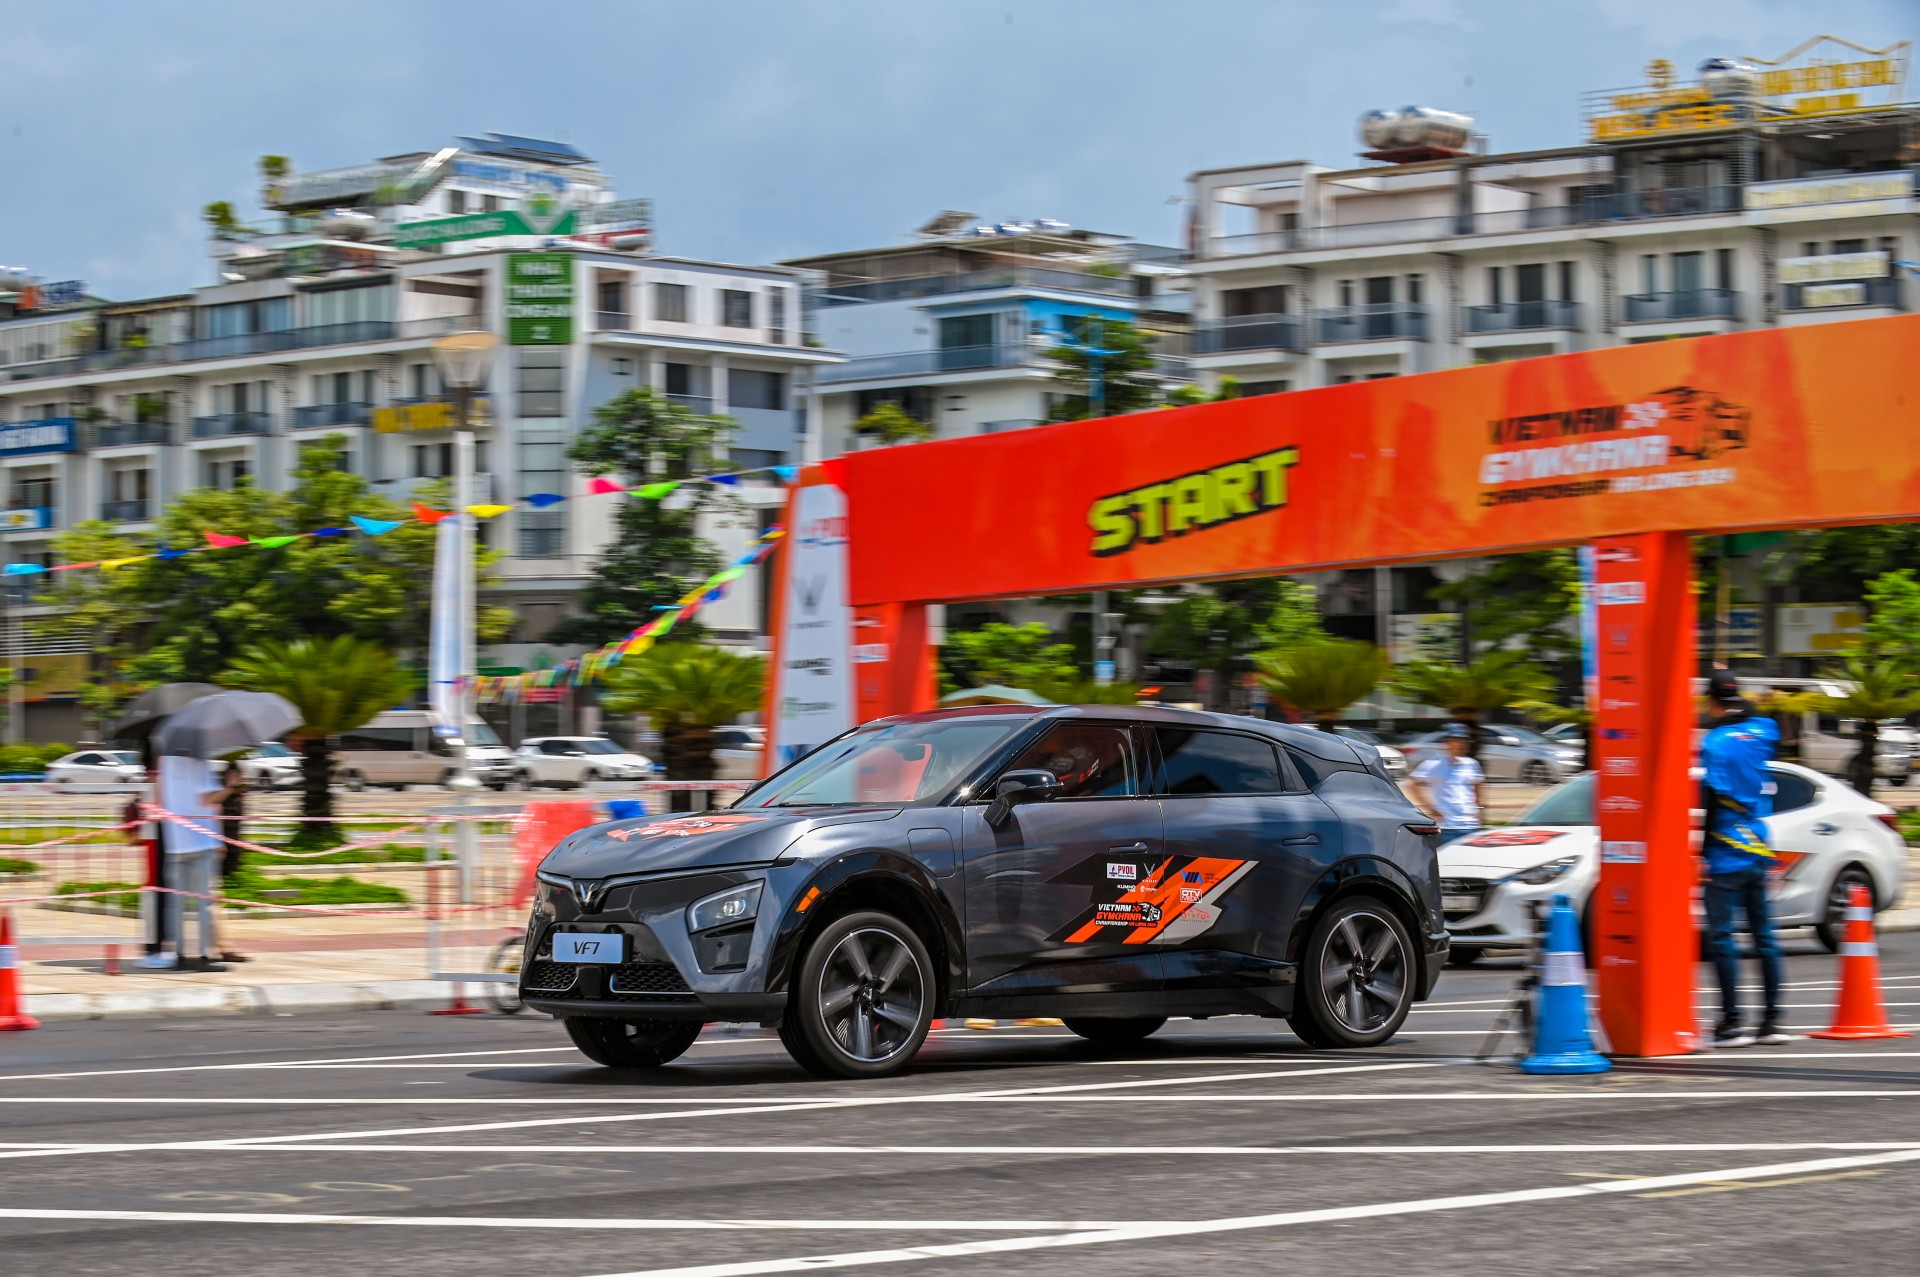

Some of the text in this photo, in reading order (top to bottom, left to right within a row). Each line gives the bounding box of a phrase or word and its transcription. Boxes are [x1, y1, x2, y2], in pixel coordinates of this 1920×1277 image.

[1488, 405, 1624, 445] VIETNAM
[1478, 435, 1669, 484] GYMKHANA
[1088, 446, 1300, 558] START
[1118, 866, 1135, 875] PVOIL
[1098, 903, 1132, 912] VIETNAM
[1096, 912, 1142, 921] GYMKHANA
[573, 941, 600, 955] VF7
